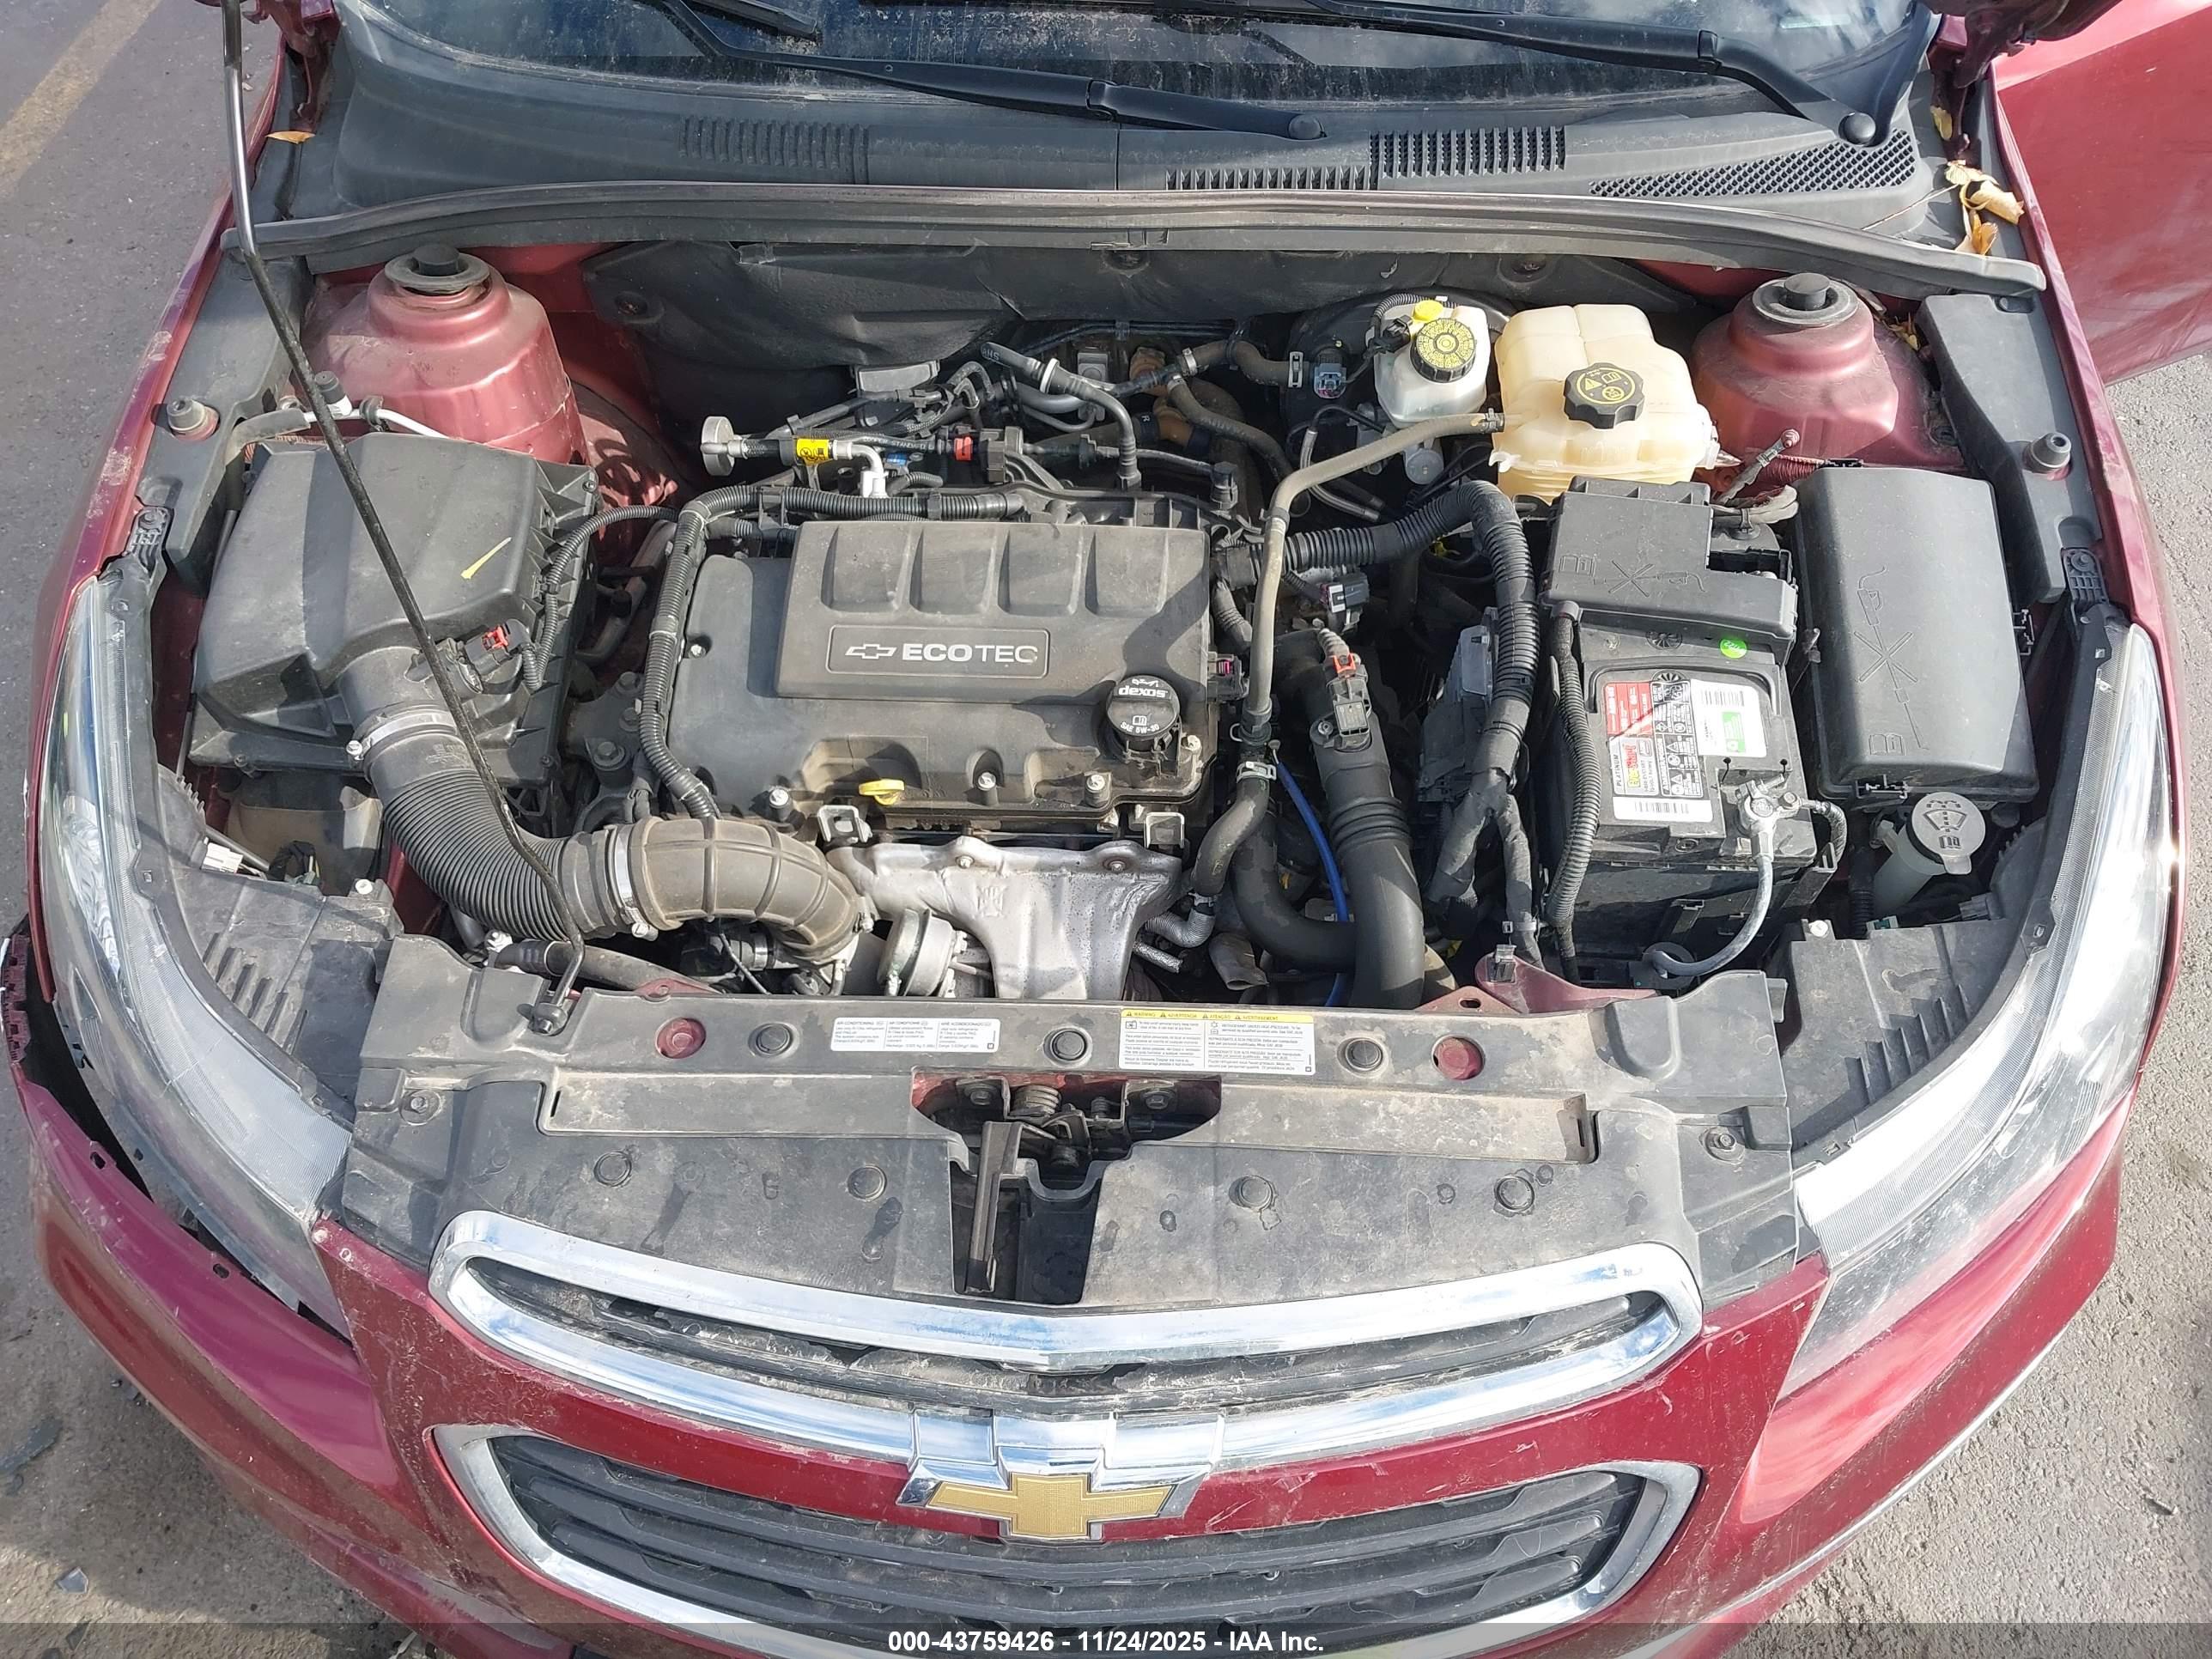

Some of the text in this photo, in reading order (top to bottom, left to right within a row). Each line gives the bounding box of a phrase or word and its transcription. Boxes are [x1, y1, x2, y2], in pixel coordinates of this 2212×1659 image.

[902, 643, 1038, 663] ECOTEC
[1118, 685, 1168, 698] dexos
[1120, 721, 1160, 734] SAE 5W-30
[1613, 754, 1622, 787] PLATINUM
